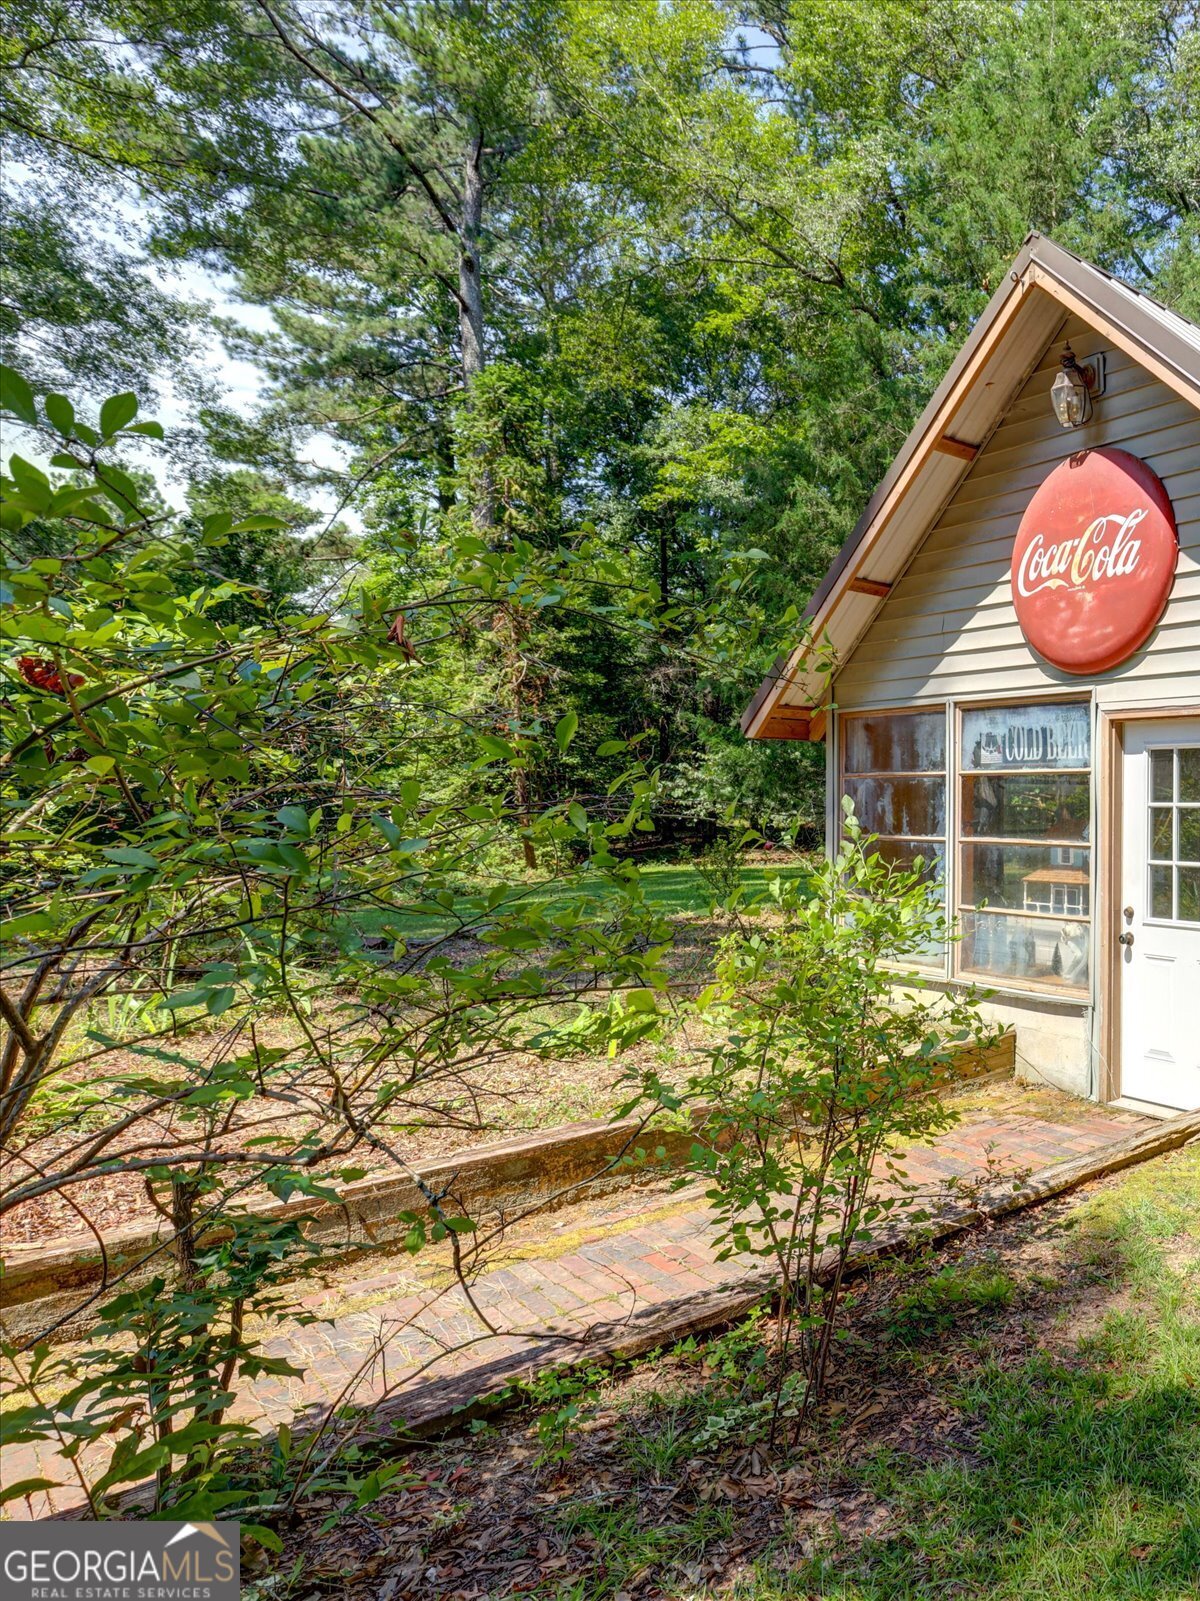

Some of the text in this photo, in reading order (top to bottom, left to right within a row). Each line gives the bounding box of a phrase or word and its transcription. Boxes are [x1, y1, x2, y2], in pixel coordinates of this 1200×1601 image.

[1017, 508, 1149, 597] Coca-Cola
[1005, 719, 1089, 761] COLD BEER
